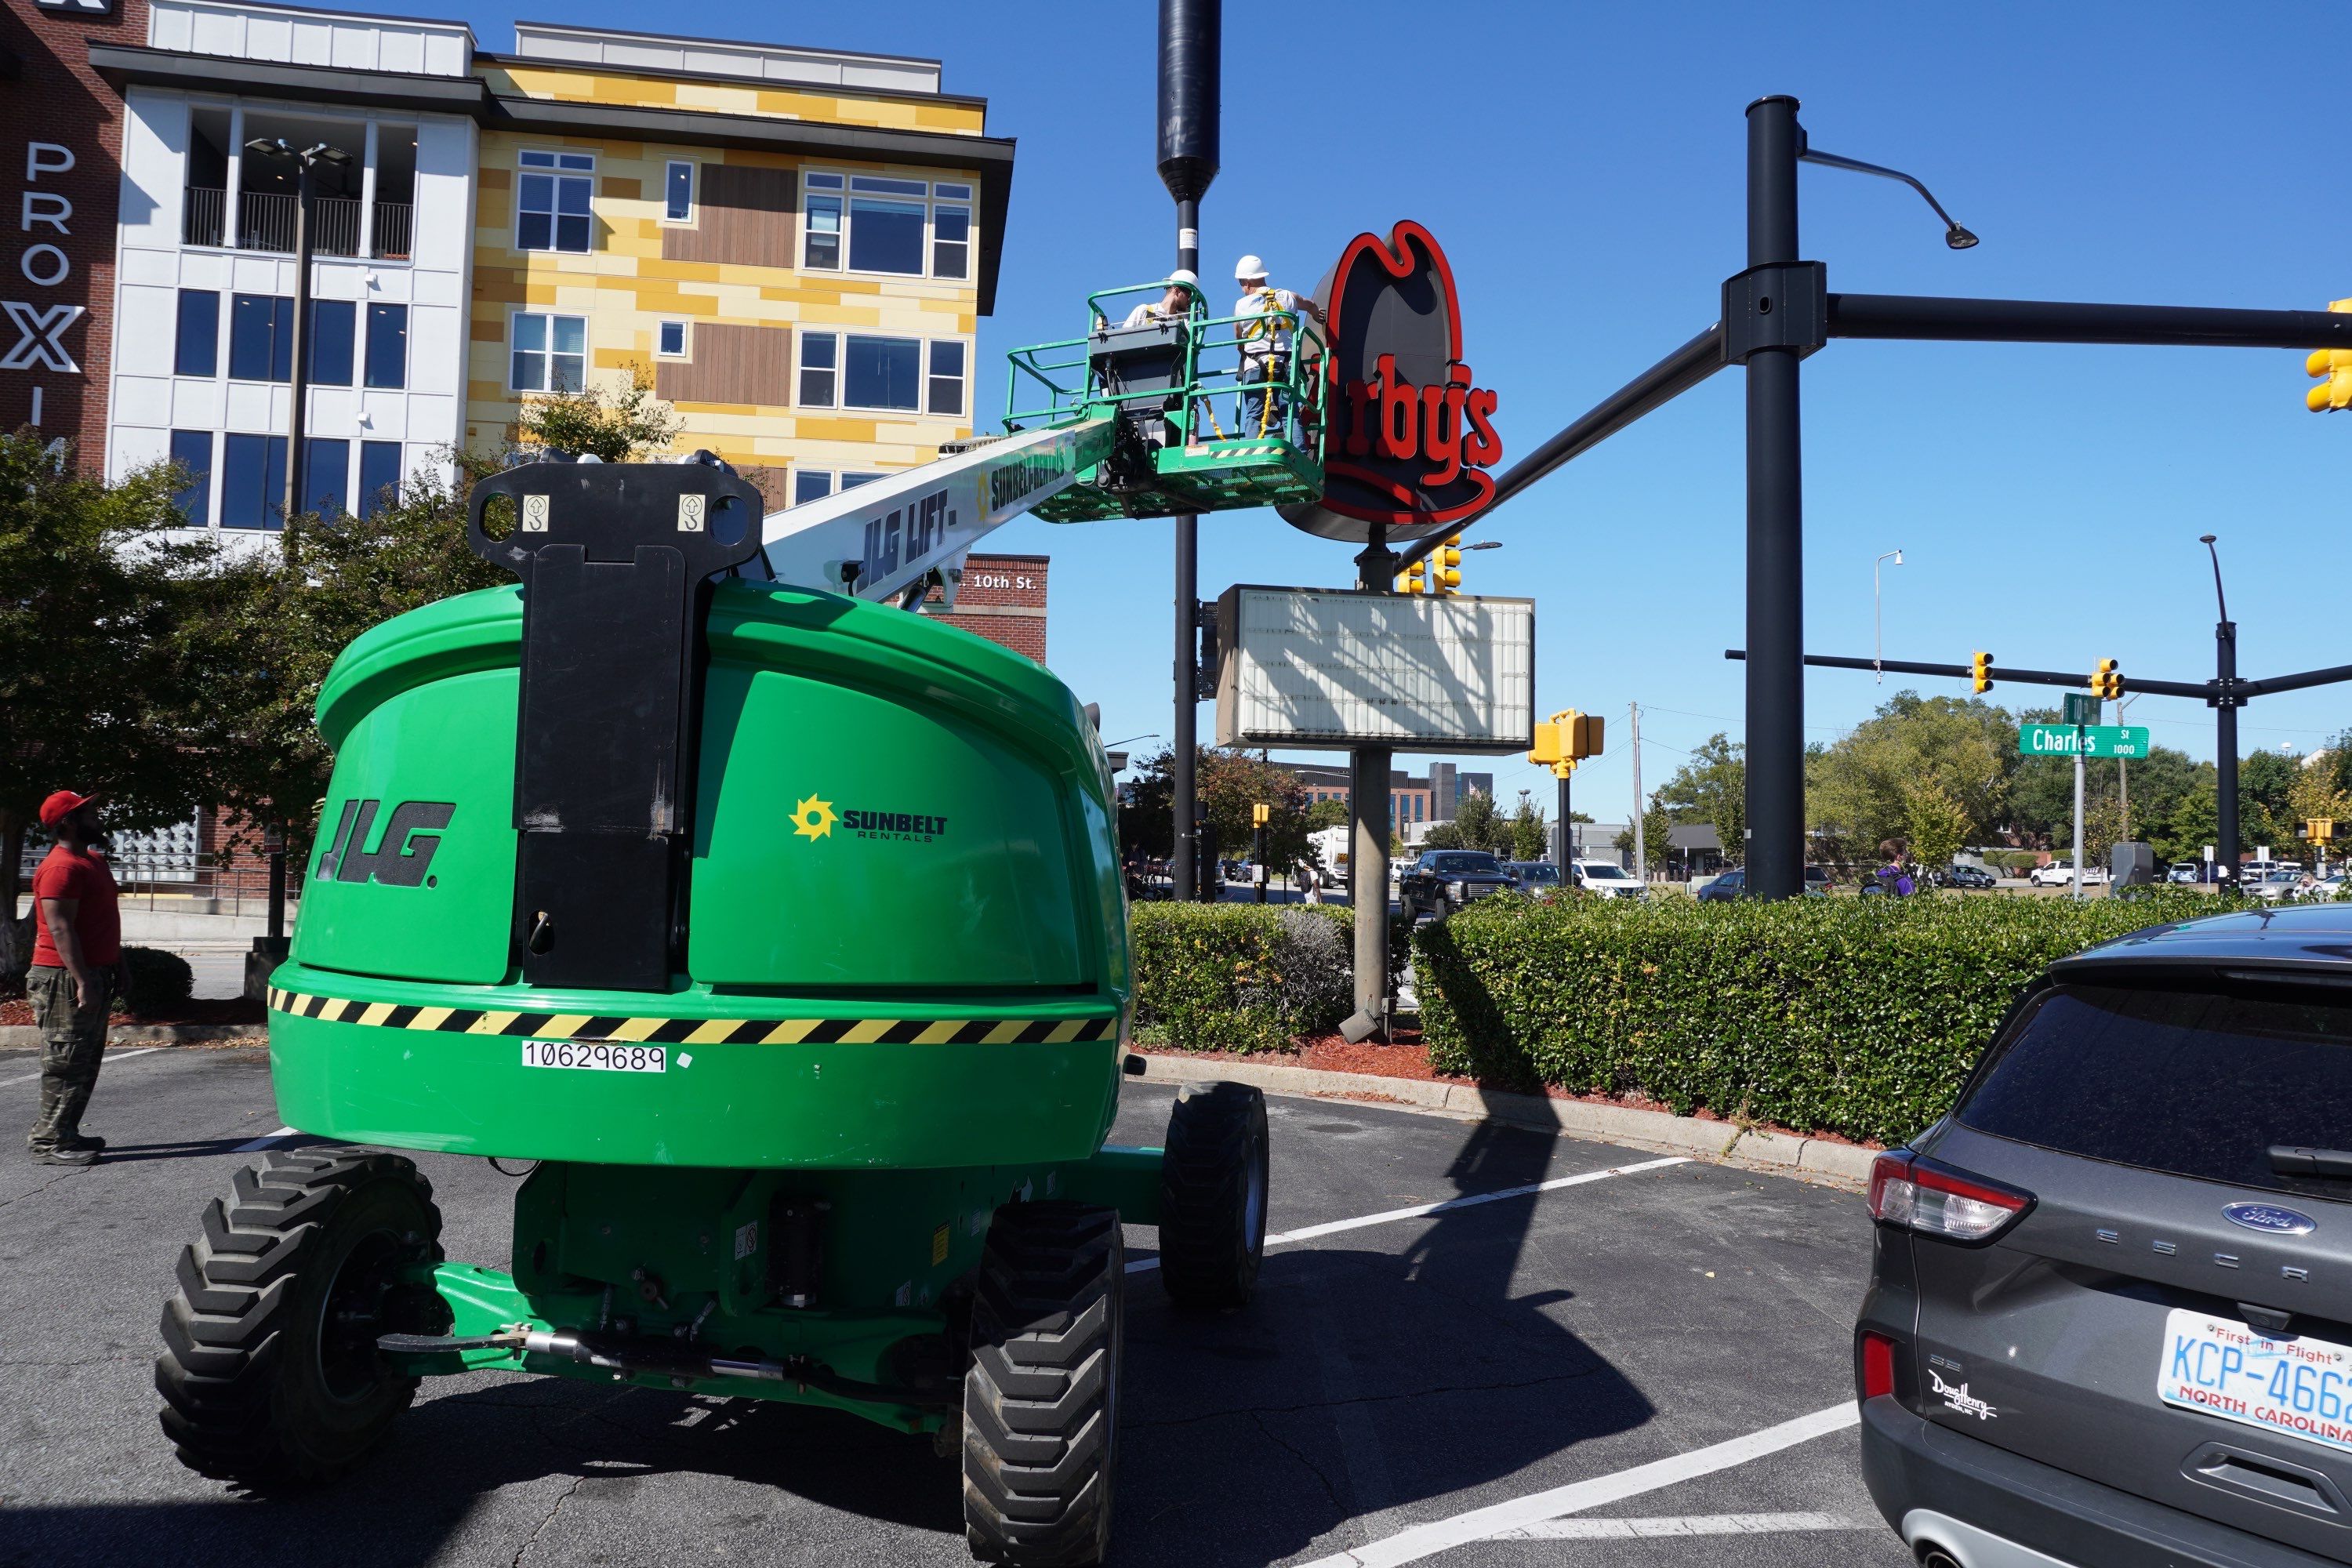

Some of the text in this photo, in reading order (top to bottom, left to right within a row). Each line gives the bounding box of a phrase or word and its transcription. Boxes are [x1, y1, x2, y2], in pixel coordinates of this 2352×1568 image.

[0, 141, 86, 506] PROXI
[974, 575, 1036, 590] 10th St.
[2033, 728, 2096, 753] Charles
[2121, 730, 2129, 739] St
[2114, 744, 2135, 754] 1000
[843, 809, 948, 835] SUNBELT
[858, 831, 933, 843] RENTALS
[525, 1043, 665, 1071] 10629689
[2241, 1207, 2294, 1229] Ford
[2216, 1327, 2333, 1365] First in Flight
[2179, 1385, 2352, 1443] NORTH CAROLINA
